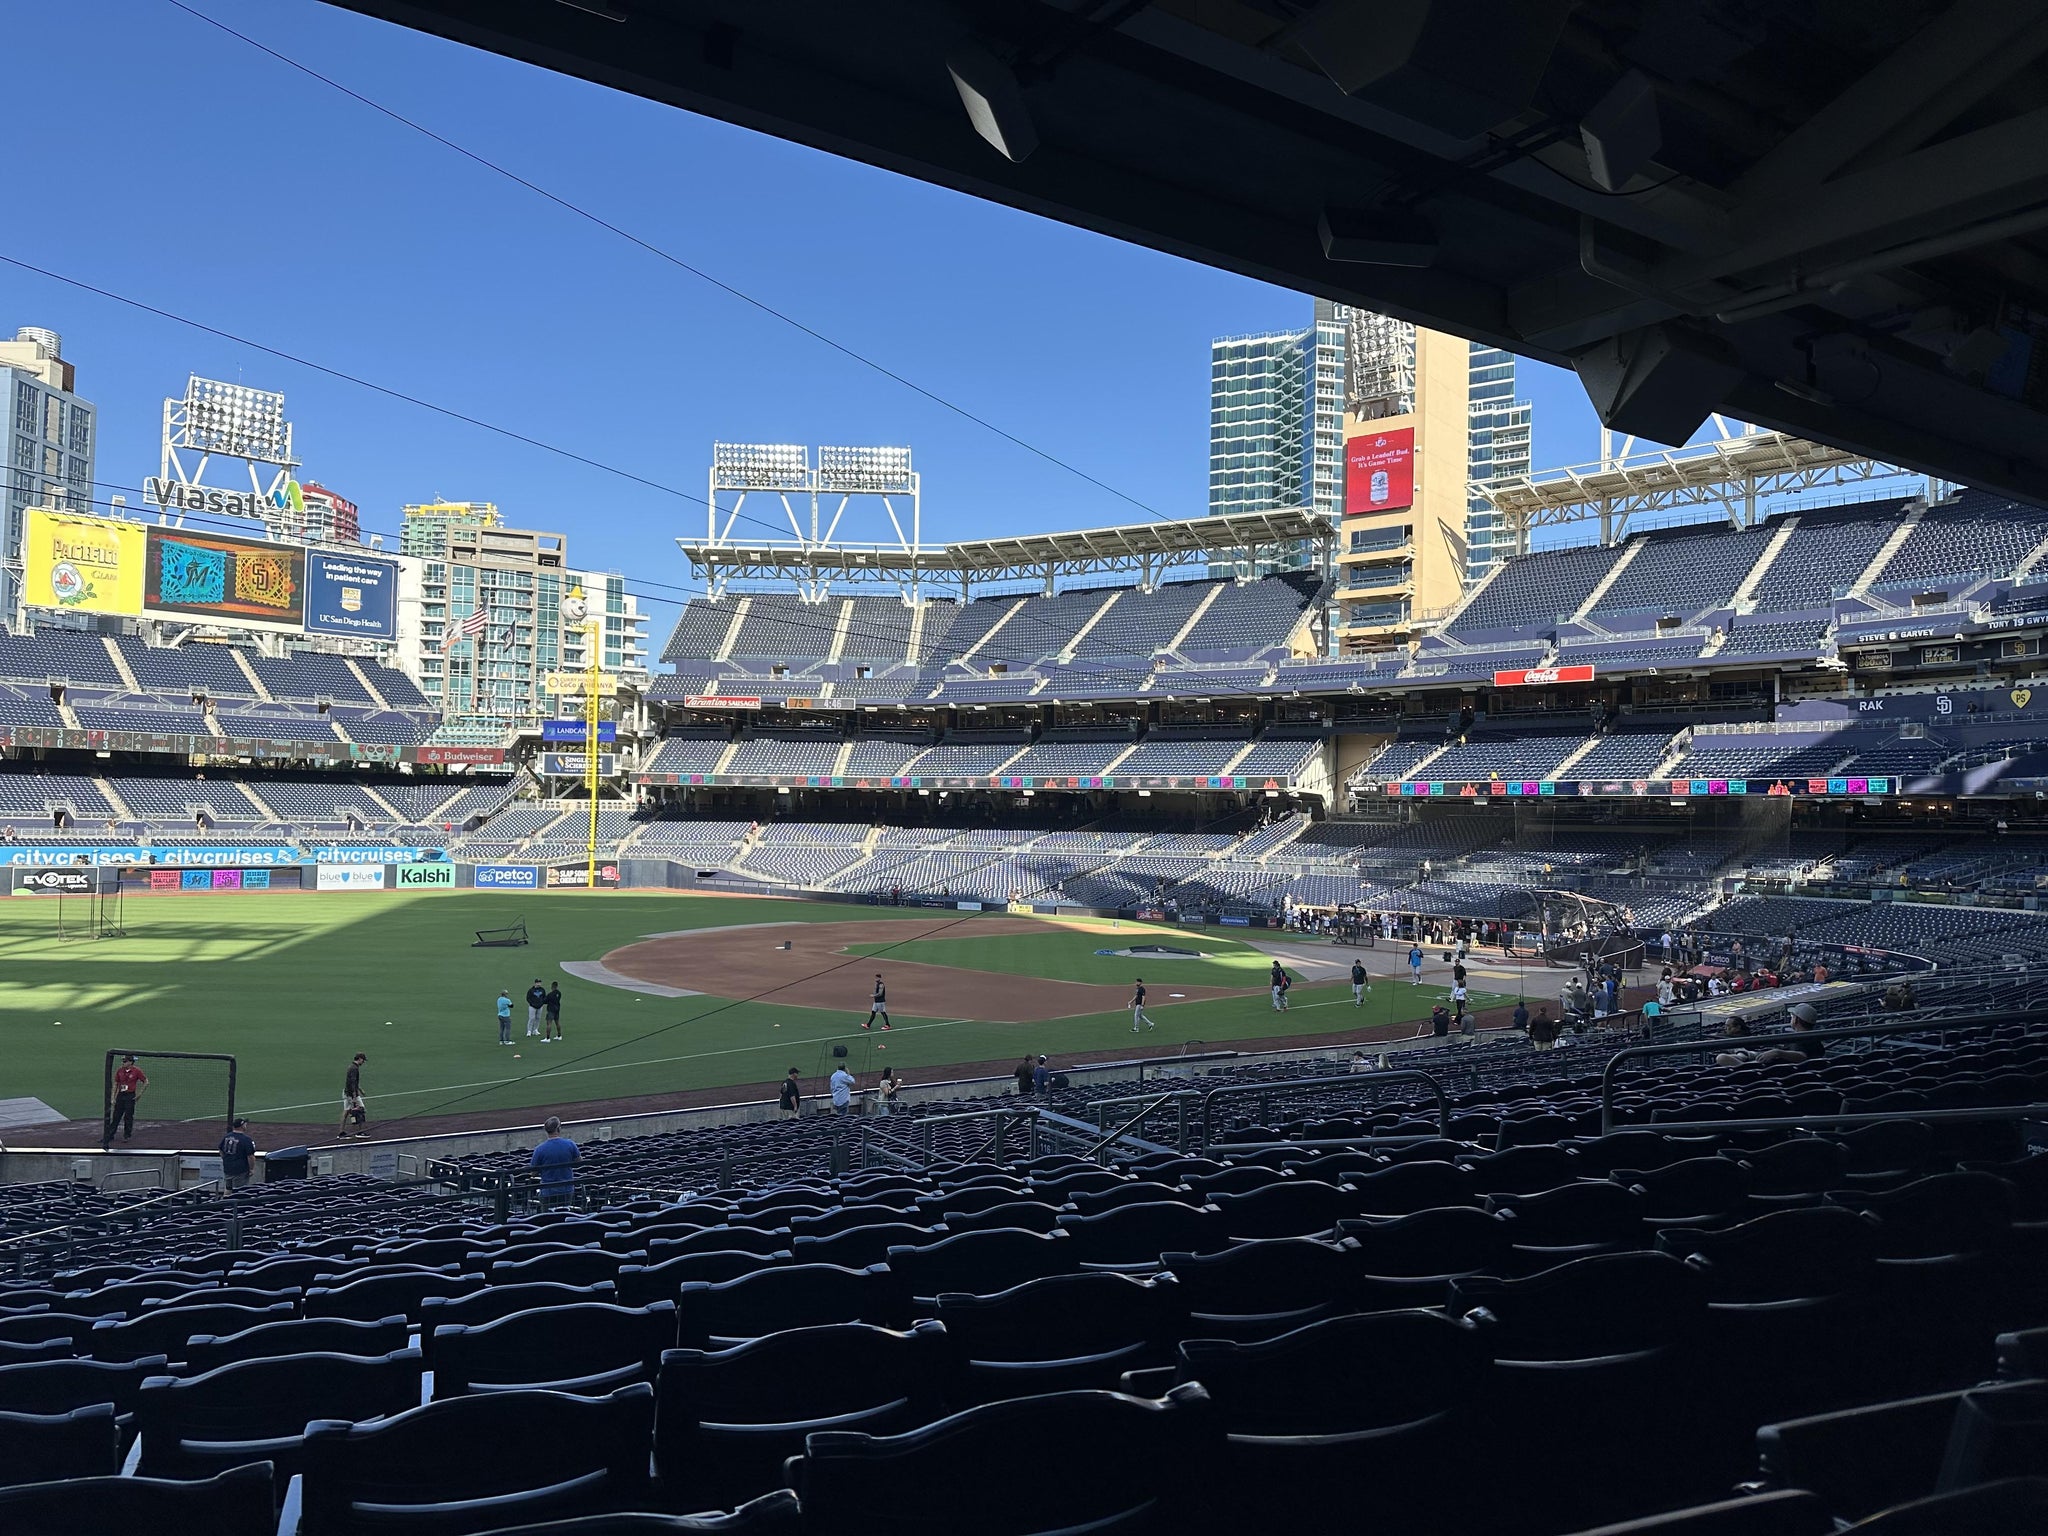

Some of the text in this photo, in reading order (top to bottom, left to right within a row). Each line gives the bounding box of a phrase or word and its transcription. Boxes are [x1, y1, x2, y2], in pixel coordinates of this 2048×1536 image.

[1351, 455, 1366, 463] Grab
[1372, 450, 1395, 460] Leadoff
[1368, 459, 1386, 467] Game
[152, 477, 261, 519] Viasat
[322, 561, 383, 578] Leading the way
[326, 571, 378, 586] in patient care
[320, 614, 382, 628] UC San Diego Health
[1988, 620, 2010, 629] TONY
[2013, 617, 2024, 627] 19
[1858, 629, 1934, 643] STEVE 6 GARVEY
[686, 696, 760, 707] Tarantino SAUSAGES
[823, 698, 842, 708] 4:46
[2016, 694, 2026, 703] PS
[1859, 700, 1884, 711] RAK
[10, 727, 17, 737] 2
[57, 730, 63, 738] 3
[103, 731, 109, 740] 0
[9, 737, 16, 746] 3
[57, 739, 63, 748] 0
[190, 735, 196, 744] 0
[102, 741, 108, 750] 3
[190, 744, 196, 753] 0
[444, 751, 494, 761] Budweiser
[165, 849, 274, 865] citycruises
[317, 847, 413, 862] citycruises
[319, 871, 373, 881] blue blue
[401, 869, 450, 883] Kalshi
[495, 869, 533, 883] petco
[560, 870, 574, 878] SLAP
[23, 872, 88, 888] EVOTEK
